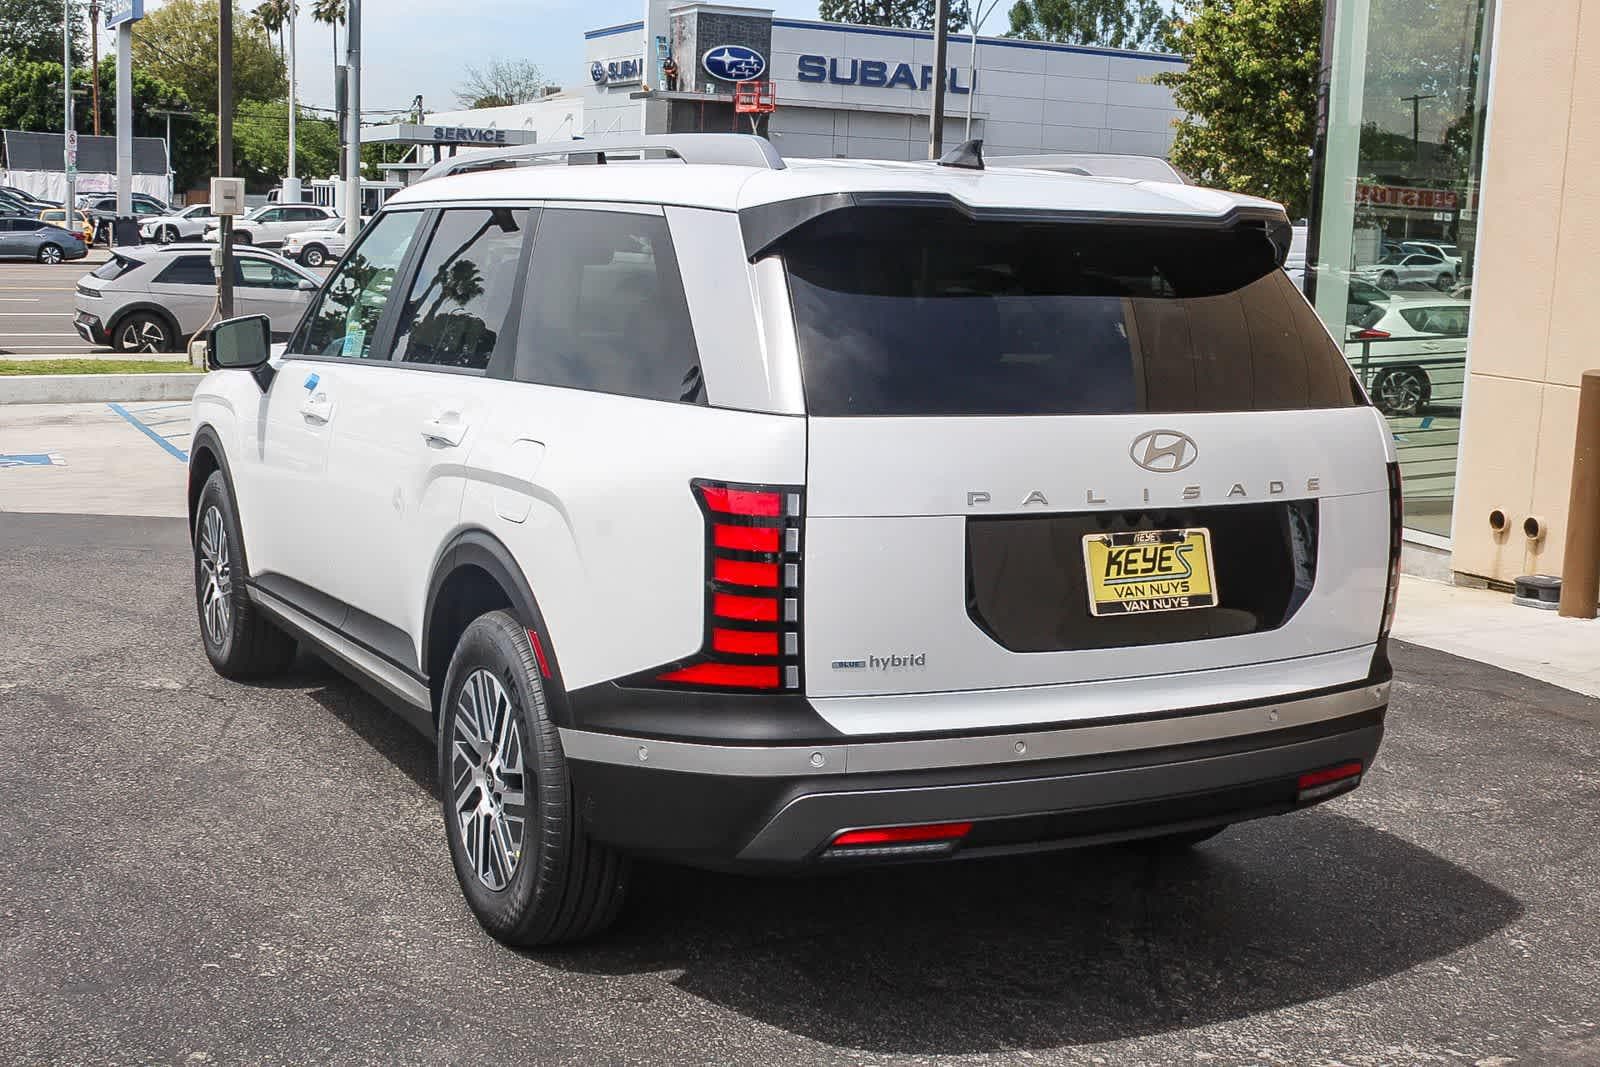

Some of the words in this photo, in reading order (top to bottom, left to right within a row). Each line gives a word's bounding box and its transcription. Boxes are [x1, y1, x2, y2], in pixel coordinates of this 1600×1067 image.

[433, 127, 505, 142] SERVICE
[967, 477, 1321, 505] PALISADE
[1104, 544, 1193, 577] KEYES
[1114, 585, 1145, 598] VAN
[1150, 581, 1190, 595] NUYS
[1123, 600, 1151, 612] VAN
[1153, 597, 1189, 609] NUYS
[869, 653, 926, 671] hybrid
